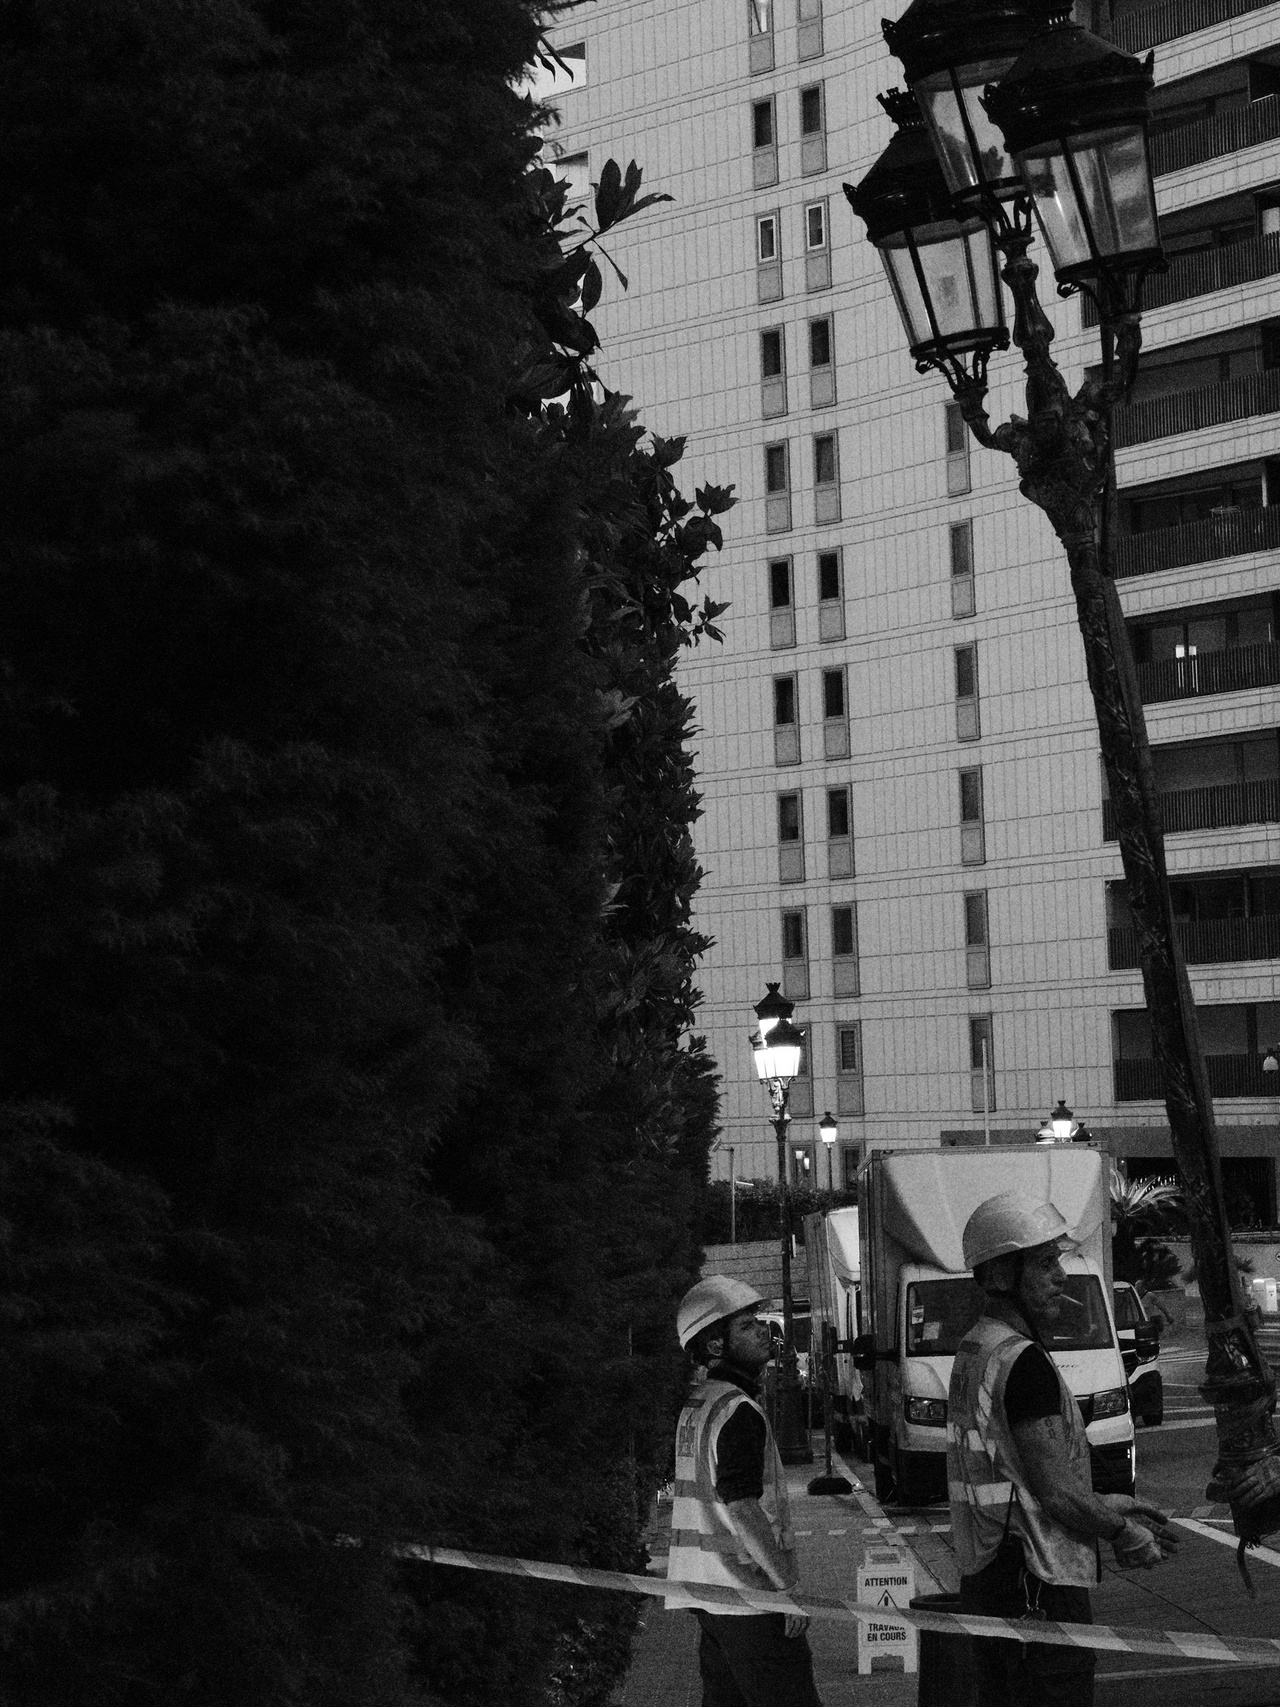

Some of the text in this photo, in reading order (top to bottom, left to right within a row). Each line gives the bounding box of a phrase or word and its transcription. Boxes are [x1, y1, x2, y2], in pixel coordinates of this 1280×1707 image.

[864, 1577, 907, 1587] ATTENTION
[867, 1632, 906, 1641] EN COURS
